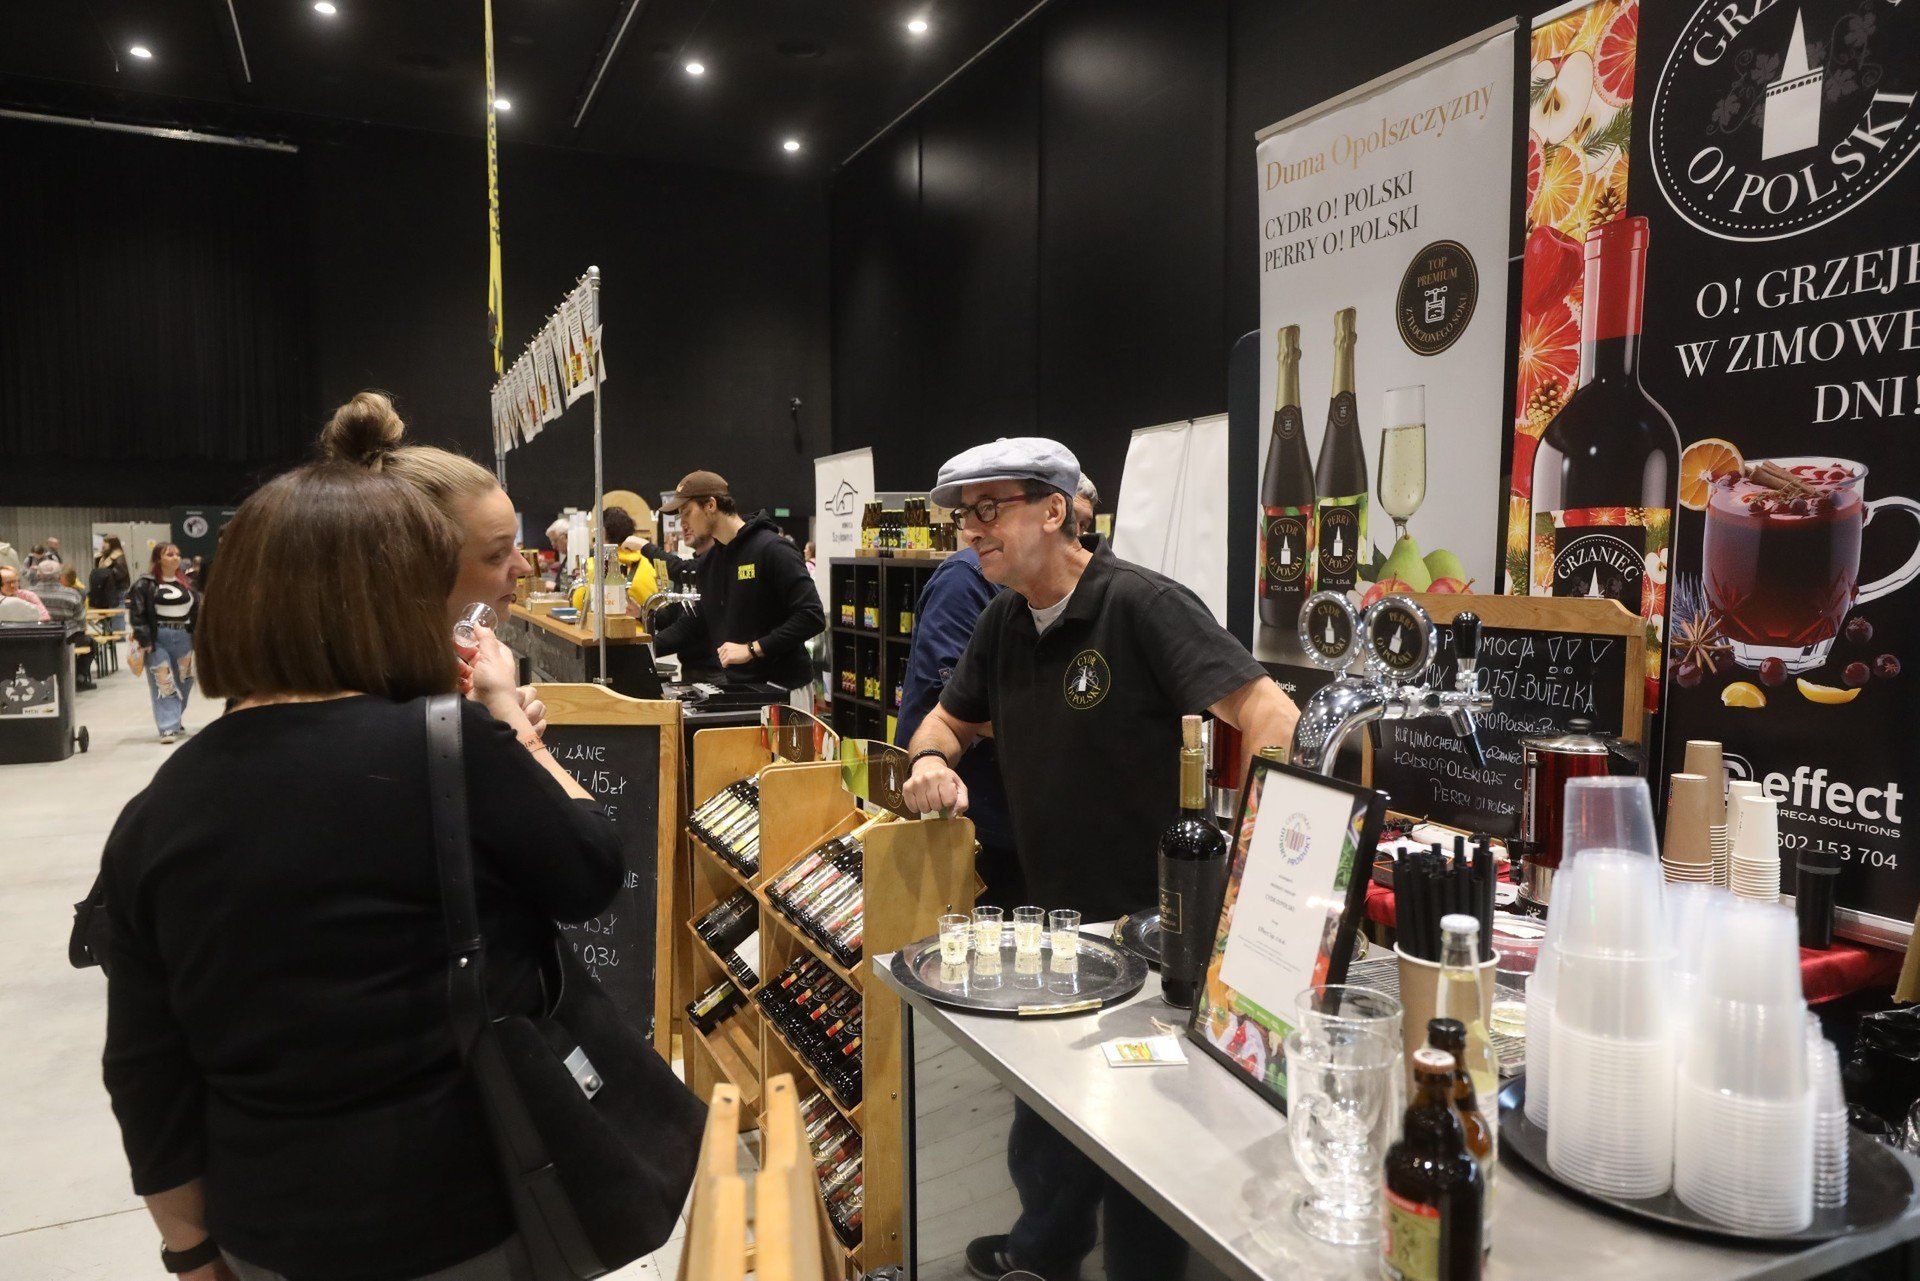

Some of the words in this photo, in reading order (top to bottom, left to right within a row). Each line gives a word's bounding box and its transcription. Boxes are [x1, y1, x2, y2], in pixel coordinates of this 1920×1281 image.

[1266, 152, 1326, 192] Duma
[1331, 82, 1494, 170] Opolszczyzny
[1687, 146, 1736, 201] O!
[1729, 88, 1918, 215] POLSKI
[1264, 205, 1314, 241] CYDR
[1317, 197, 1338, 225] O!
[1344, 170, 1414, 217] POLSKI
[1264, 235, 1319, 273] PERRY
[1322, 229, 1344, 255] O!
[1350, 204, 1421, 249] POLSKI
[1417, 267, 1458, 288] PREMIUM
[1429, 257, 1447, 271] TOP
[1696, 277, 1742, 319] O!
[1675, 339, 1719, 379] W
[1274, 523, 1299, 537] CYDR
[1558, 546, 1640, 583] GRZANIEC
[1444, 630, 1535, 669] PMOCJA
[1762, 765, 1904, 824] effect
[1819, 816, 1901, 838] SOLUTIONS
[1857, 847, 1898, 870] 704
